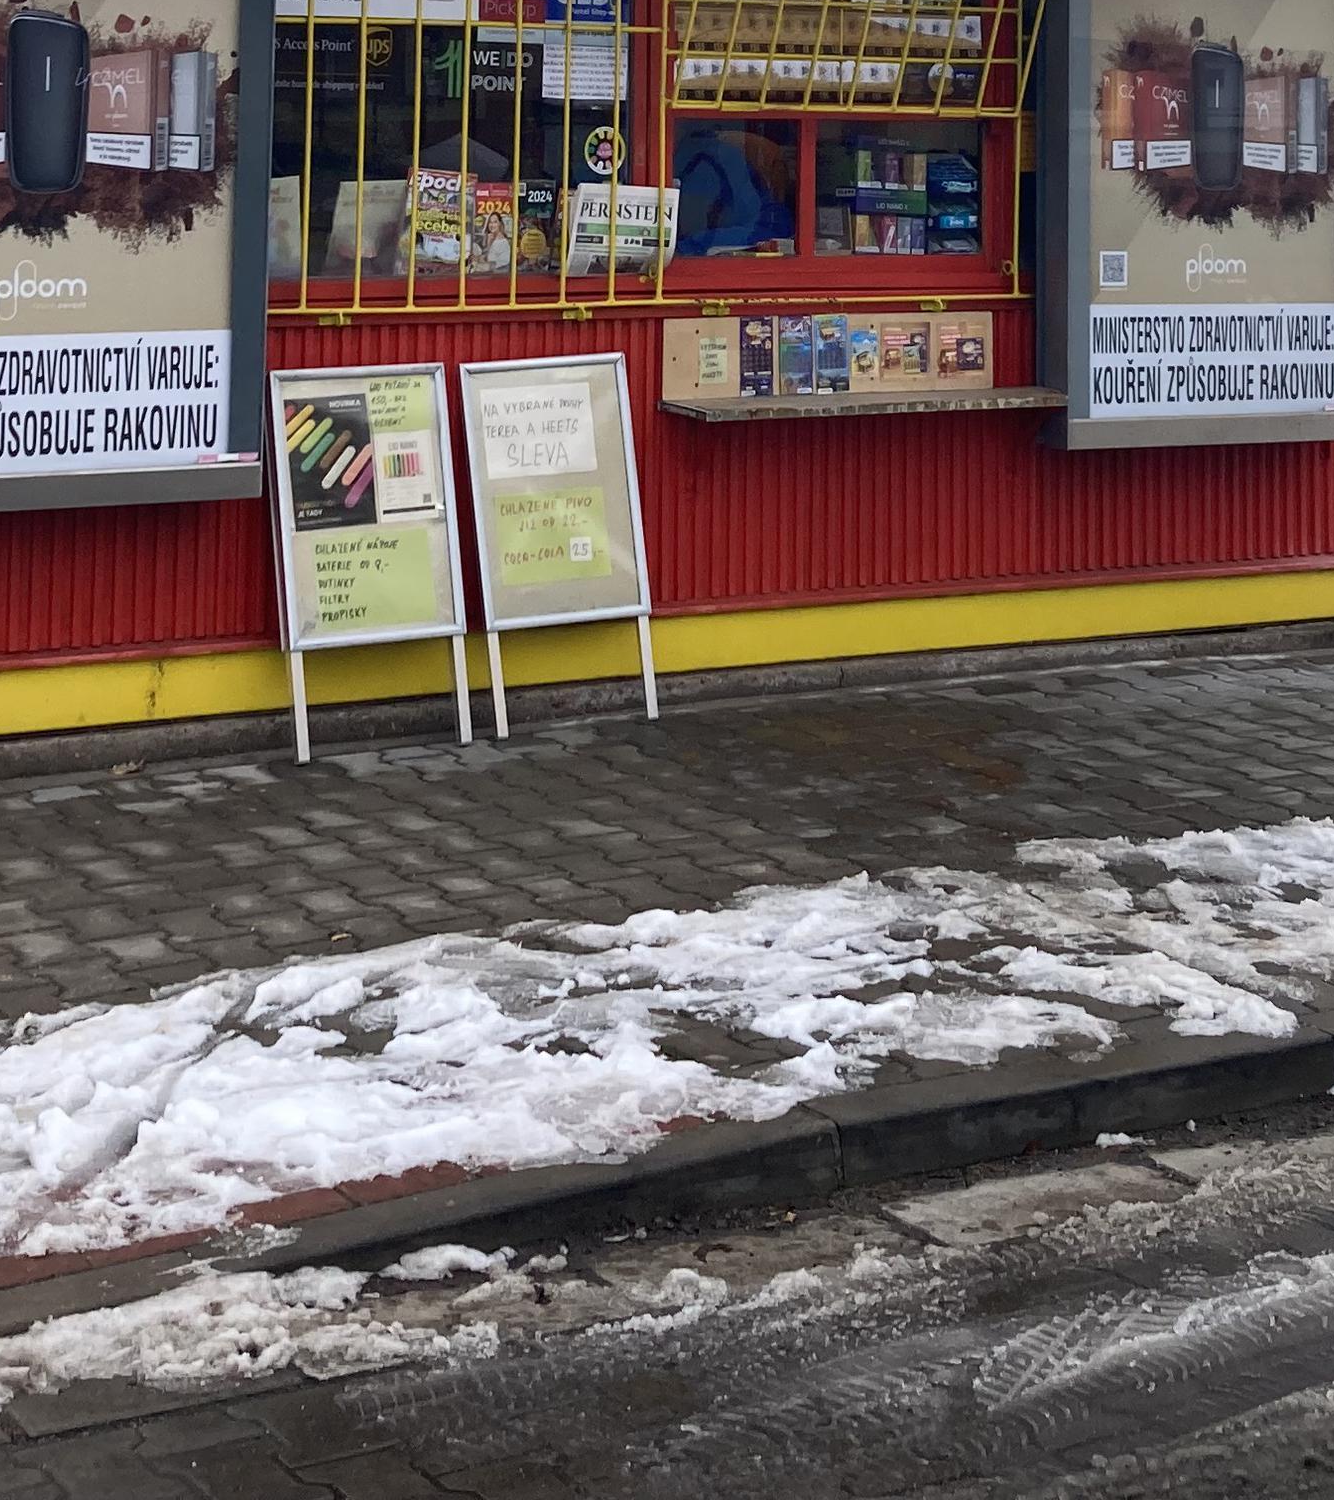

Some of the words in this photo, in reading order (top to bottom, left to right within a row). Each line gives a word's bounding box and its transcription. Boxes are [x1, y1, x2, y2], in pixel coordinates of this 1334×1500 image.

[284, 38, 319, 51] Acces
[321, 39, 352, 51] Point
[528, 190, 553, 203] 2024
[478, 200, 511, 214] 2024
[1186, 243, 1247, 292] ploom
[1093, 316, 1185, 354] MINISTERSTVO
[1189, 308, 1285, 352] ZDRAVOTNICTVÍ
[1287, 315, 1334, 351] VARUJE:
[147, 344, 219, 391] VARUJE:
[1093, 358, 1163, 405] KOUŘENÍ
[1167, 356, 1254, 403] ZPŮSOBUJE
[1260, 363, 1334, 401] RAKOVINU
[484, 403, 499, 418] NA
[103, 403, 218, 453] RAKOVINU
[486, 424, 520, 439] TEREA
[527, 421, 535, 436] A
[542, 418, 579, 435] HEETS
[507, 441, 570, 468] SLEVA
[566, 496, 593, 509] PIVO
[315, 538, 364, 556] CHLAZENÉ
[504, 545, 565, 565] COCA-COLA
[316, 560, 352, 573] BATERIE
[319, 593, 350, 605] FILTRY
[321, 606, 368, 623] PROPISKY
